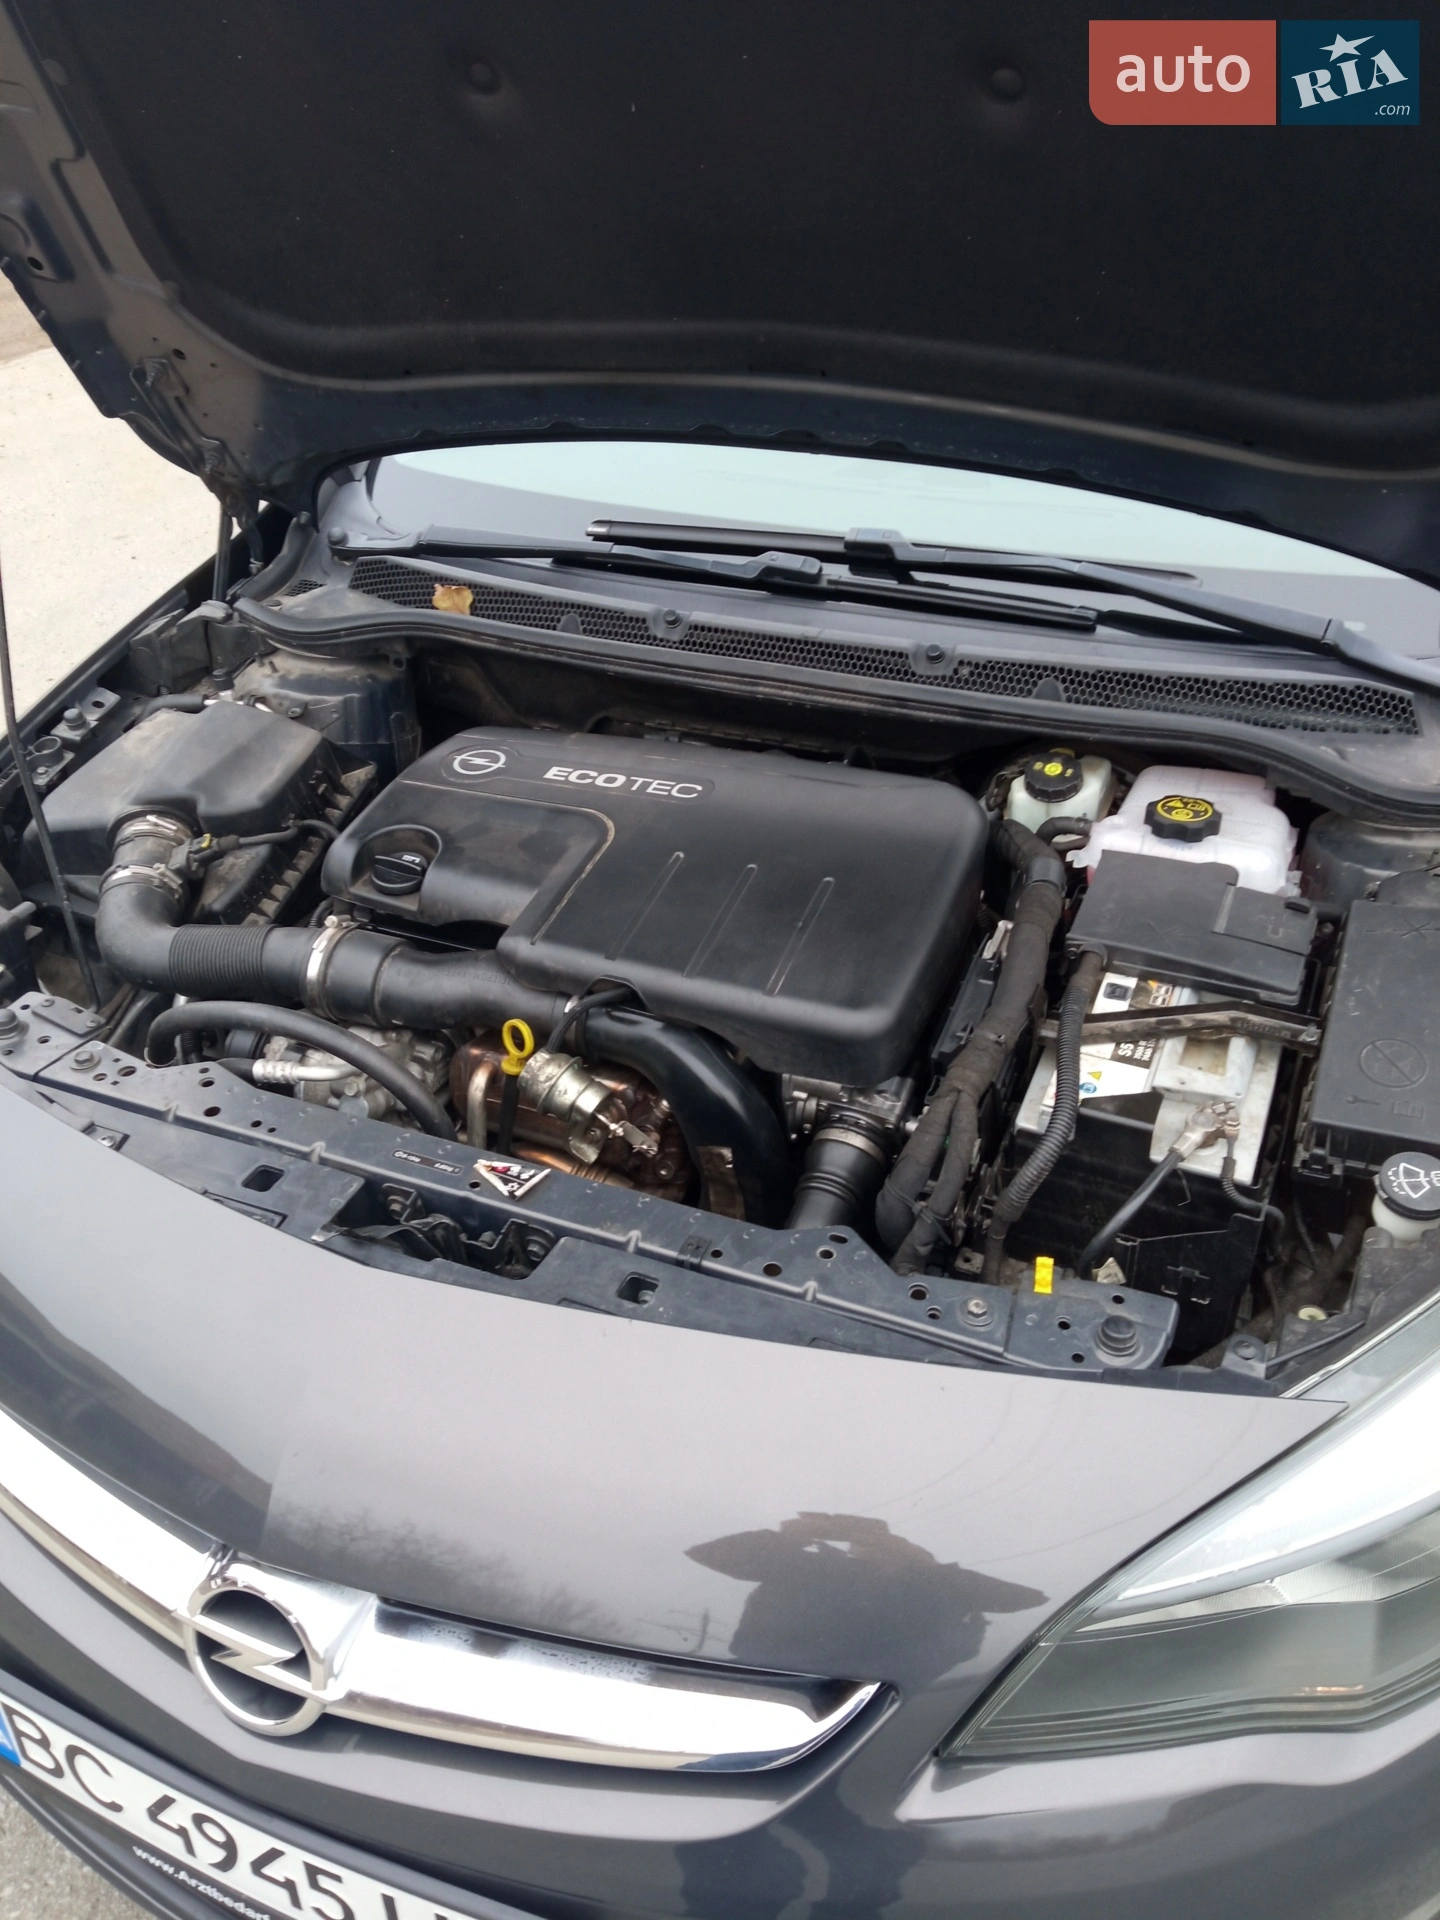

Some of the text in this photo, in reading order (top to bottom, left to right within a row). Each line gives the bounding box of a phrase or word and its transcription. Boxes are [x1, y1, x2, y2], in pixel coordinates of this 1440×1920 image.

[543, 766, 703, 799] ECOTEC
[0, 1701, 356, 1920] BC 4945
